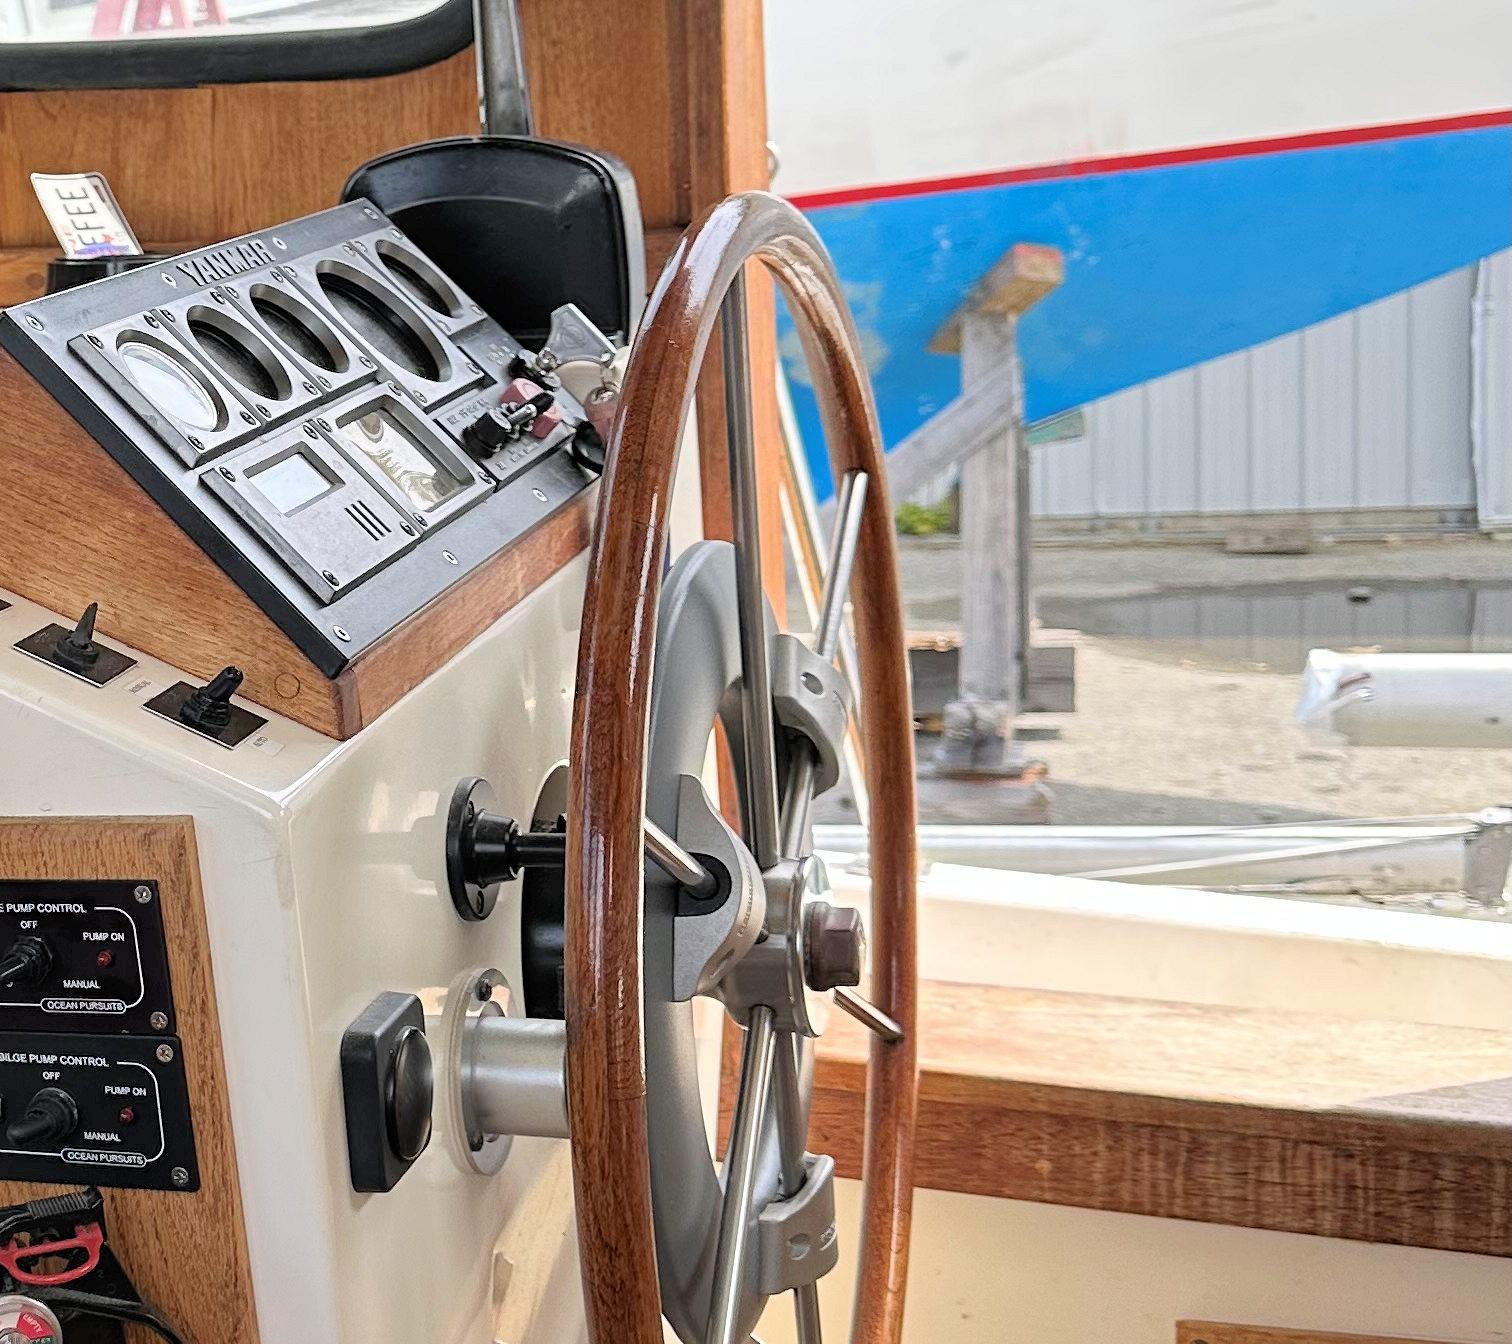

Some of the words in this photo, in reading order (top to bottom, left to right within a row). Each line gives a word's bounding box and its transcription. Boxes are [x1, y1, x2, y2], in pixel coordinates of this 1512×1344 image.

[176, 238, 276, 286] YANMAR
[6, 903, 35, 913] PUMP
[37, 904, 87, 913] CONTROL
[20, 920, 38, 929] OFF
[83, 932, 109, 941] PUMP
[110, 933, 125, 941] ON
[63, 979, 101, 989] MANUAL
[47, 1001, 79, 1010] OCEAN
[79, 1002, 124, 1011] PURSUITS
[29, 1054, 58, 1064] PUMP
[60, 1056, 109, 1067] CONTROL
[42, 1071, 61, 1080] OFF
[104, 1086, 131, 1095] PUMP
[132, 1087, 147, 1096] ON
[84, 1132, 122, 1142] MANUAL
[67, 1151, 99, 1161] OCEAN
[100, 1154, 144, 1165] PURSUITS
